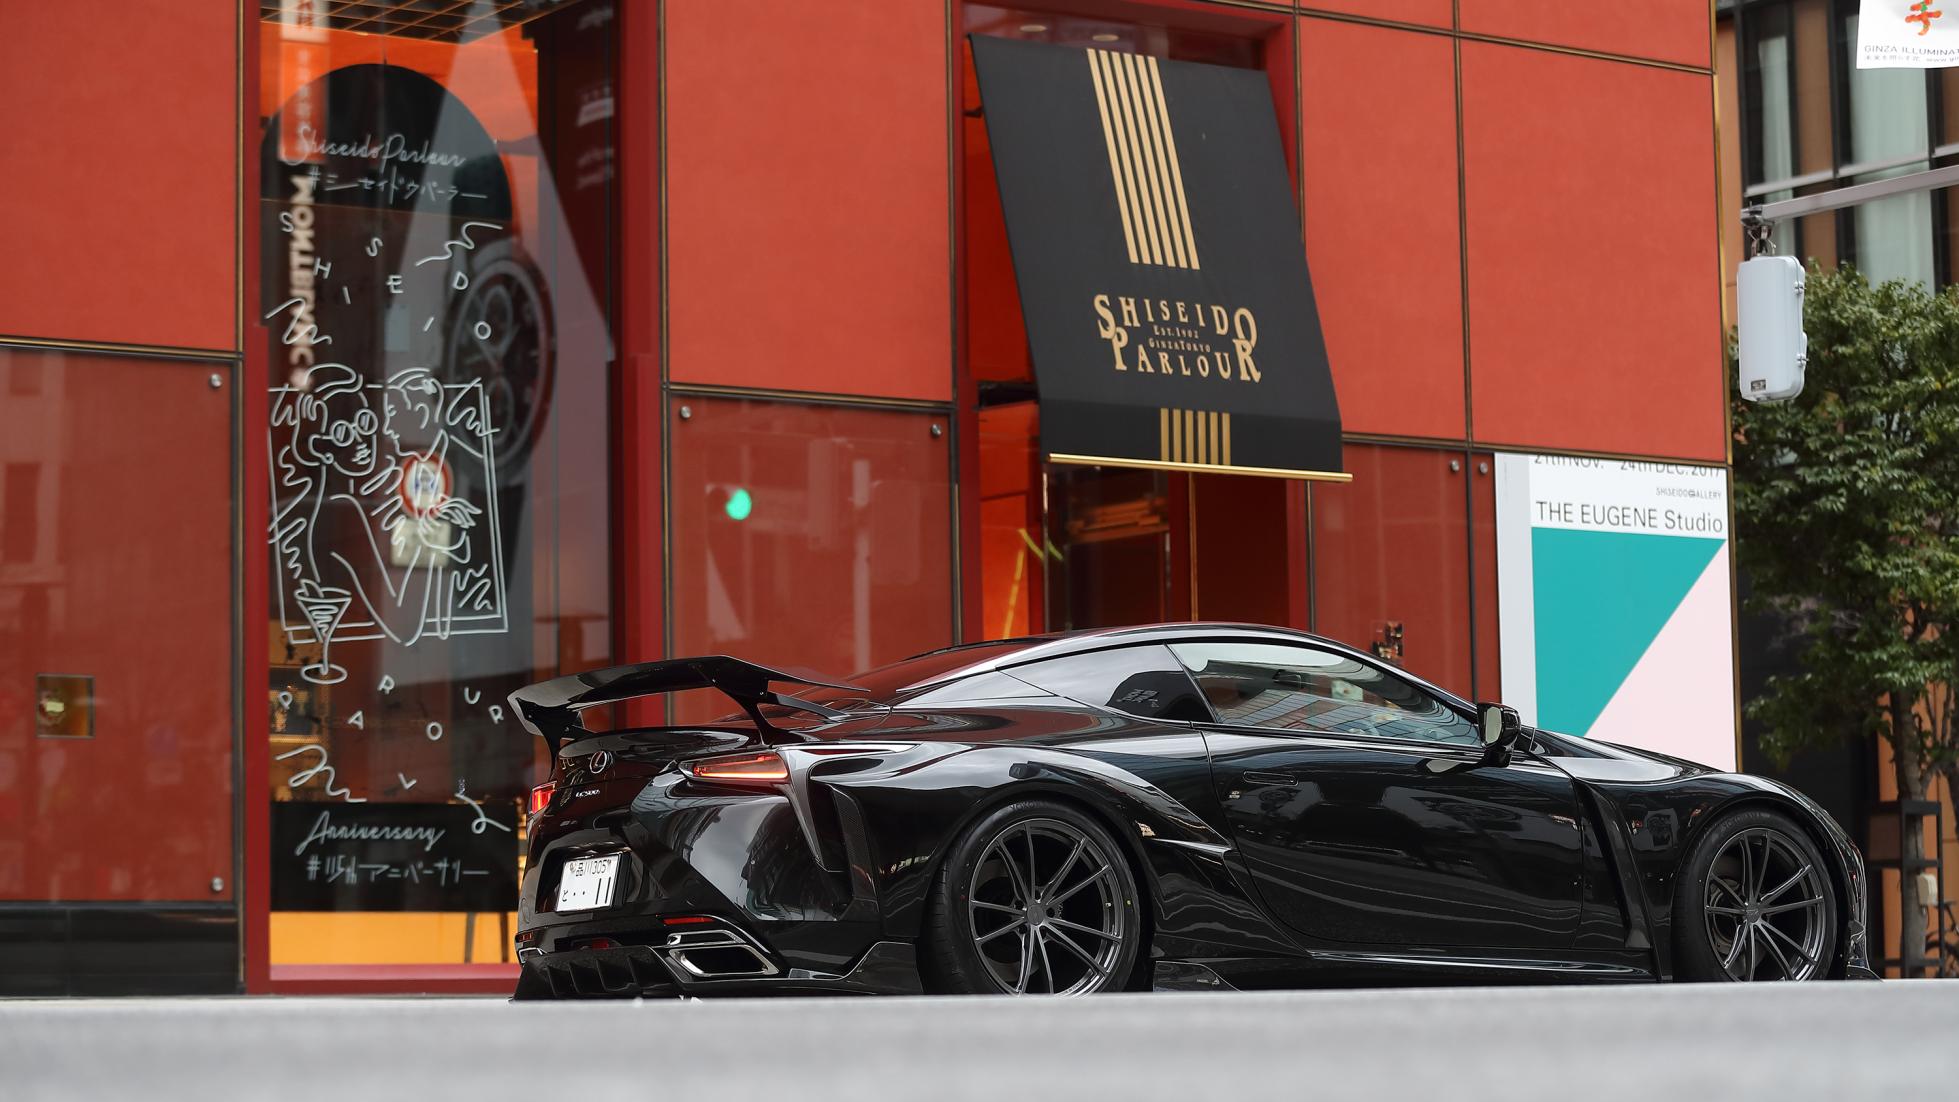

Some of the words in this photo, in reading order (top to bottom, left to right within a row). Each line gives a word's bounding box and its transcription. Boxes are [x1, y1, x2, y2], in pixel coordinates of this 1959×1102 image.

[1864, 45, 1898, 54] GINZA
[1094, 294, 1257, 348] SHISEIDO
[1112, 327, 1261, 383] PARLOUR
[1536, 500, 1573, 523] THE
[1581, 504, 1658, 528] EUGENE
[1664, 509, 1723, 533] Studio
[295, 810, 446, 856] Anniversary
